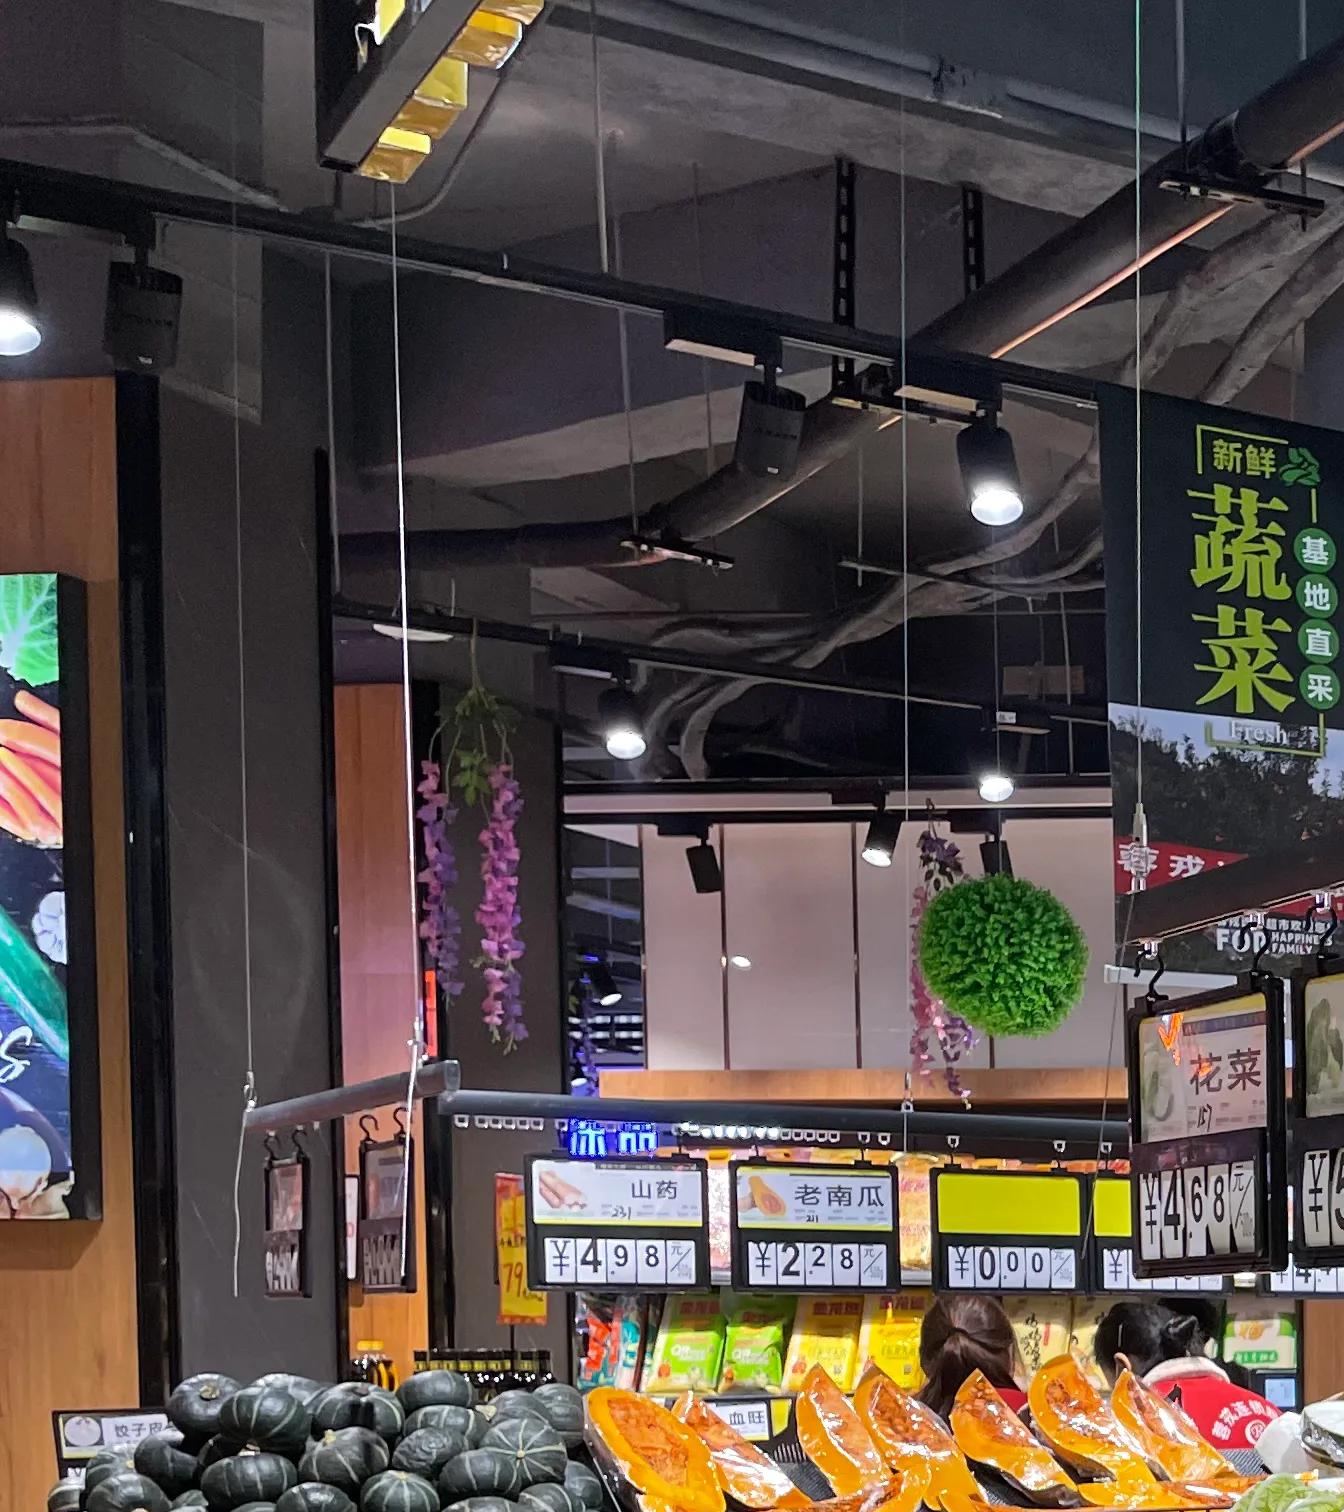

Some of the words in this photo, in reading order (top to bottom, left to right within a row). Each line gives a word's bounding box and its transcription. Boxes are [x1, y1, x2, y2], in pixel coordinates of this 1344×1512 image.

[1212, 438, 1277, 479] 新鲜
[1187, 484, 1296, 714] 蔬菜
[1301, 536, 1334, 702] 基地直采
[1273, 943, 1313, 955] FAMILY
[1190, 1048, 1262, 1096] 花菜
[630, 1179, 678, 1200] 山药
[795, 1183, 885, 1208] 老南瓜
[1143, 1174, 1225, 1245] ¥4.68
[550, 1240, 659, 1276] ¥4.98
[755, 1242, 853, 1277] ¥2.28
[954, 1247, 1044, 1281] ¥0.00
